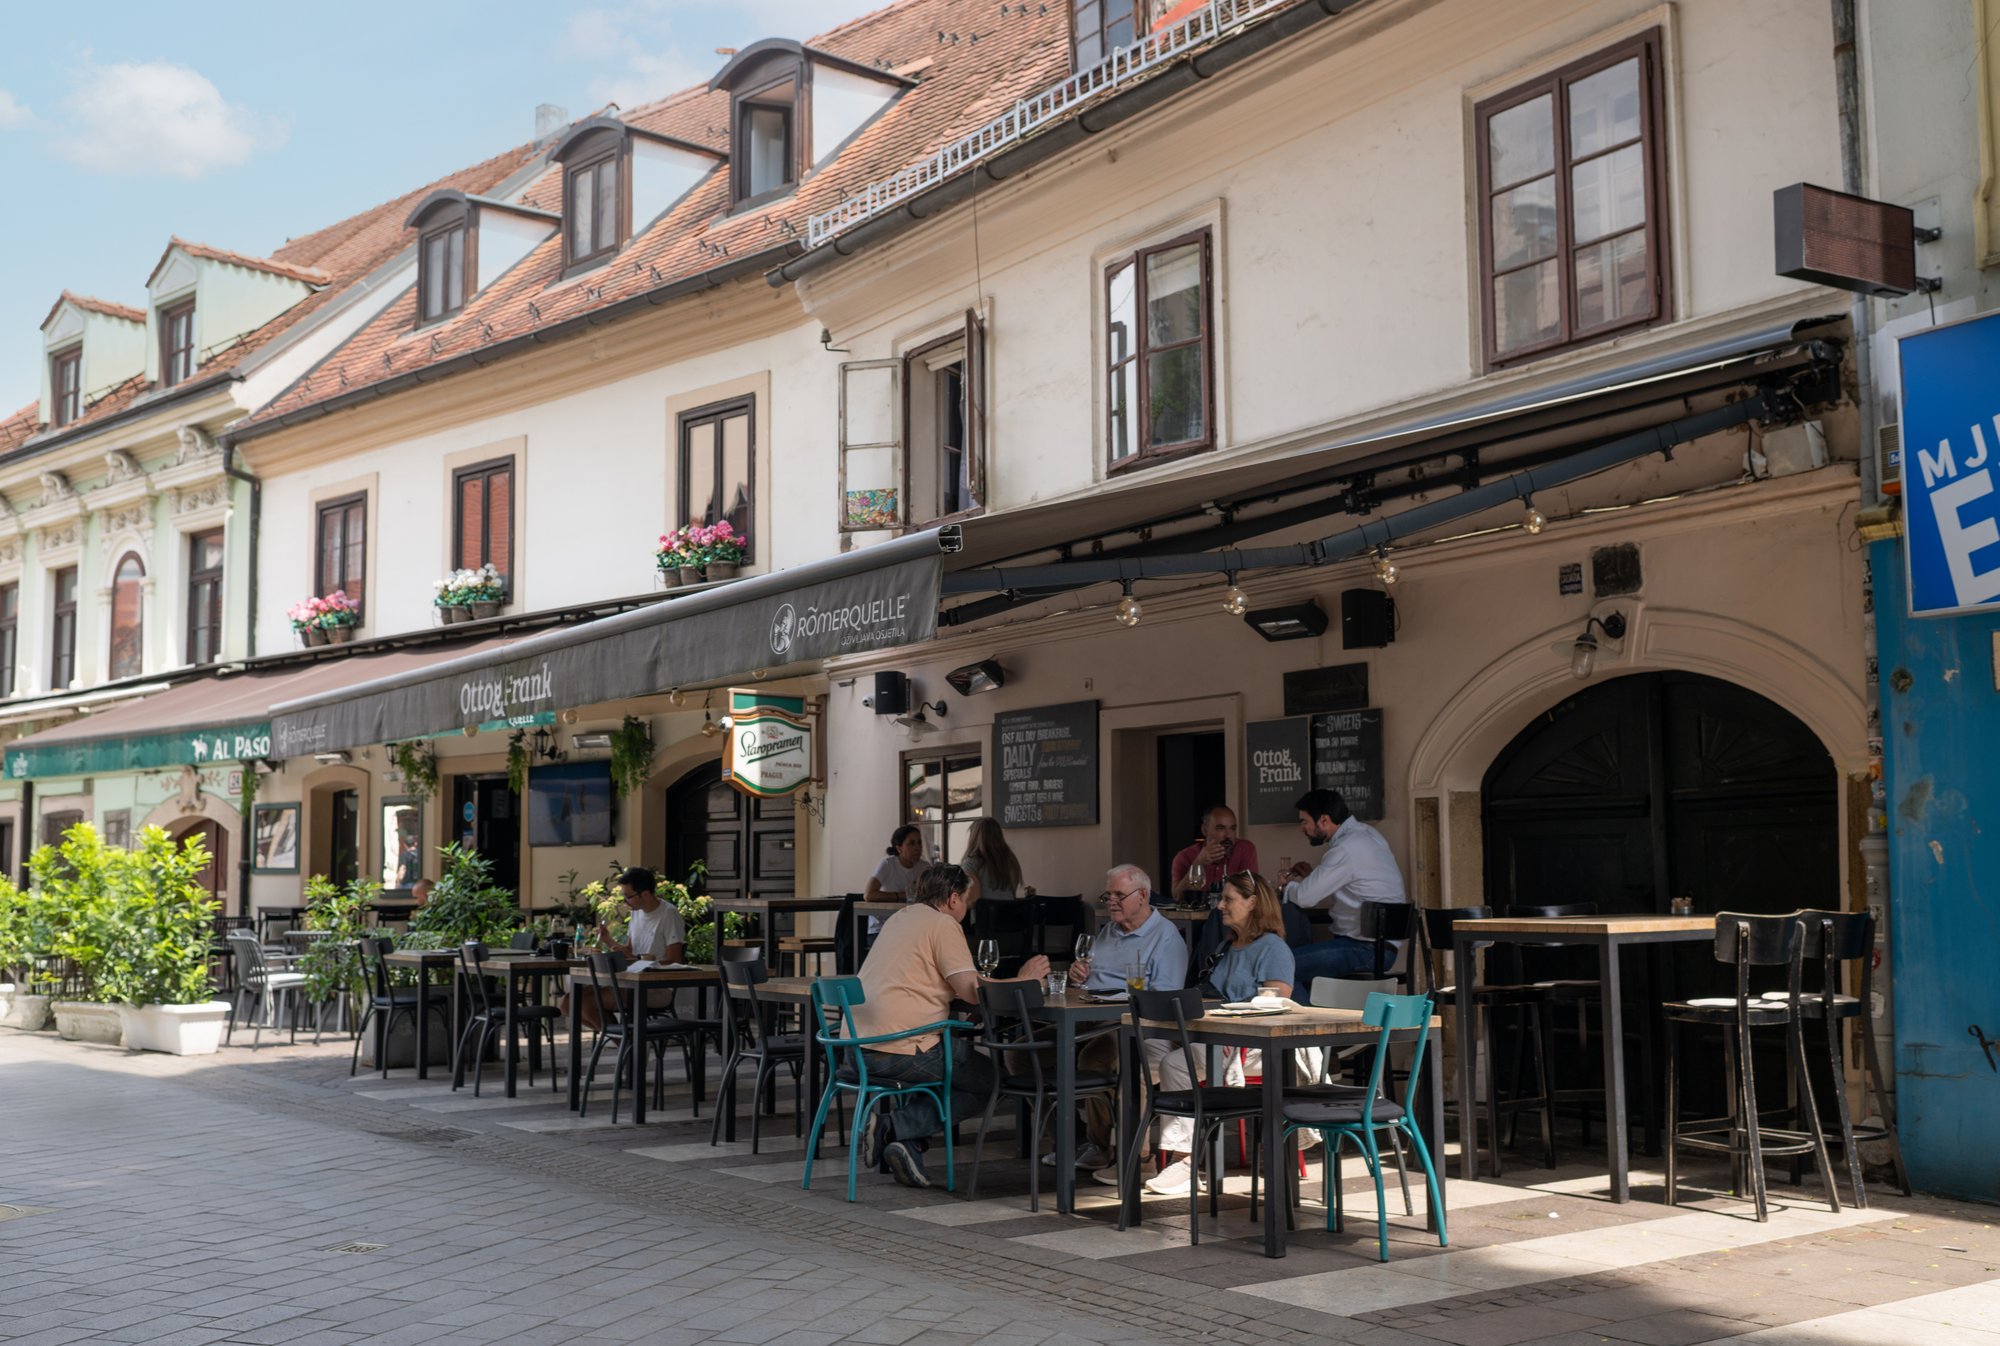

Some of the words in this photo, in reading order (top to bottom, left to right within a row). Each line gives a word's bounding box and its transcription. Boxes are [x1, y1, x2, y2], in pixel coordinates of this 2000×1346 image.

[1917, 412, 2000, 489] MJ
[1327, 712, 1361, 733] SWEETS
[213, 738, 231, 760] AL
[235, 735, 271, 758] PASO
[741, 730, 804, 758] Staropramen
[1003, 743, 1036, 769] DAILY
[1003, 767, 1032, 782] SPECIALS
[1260, 762, 1302, 784] Frank
[1004, 804, 1037, 824] SWEETS
